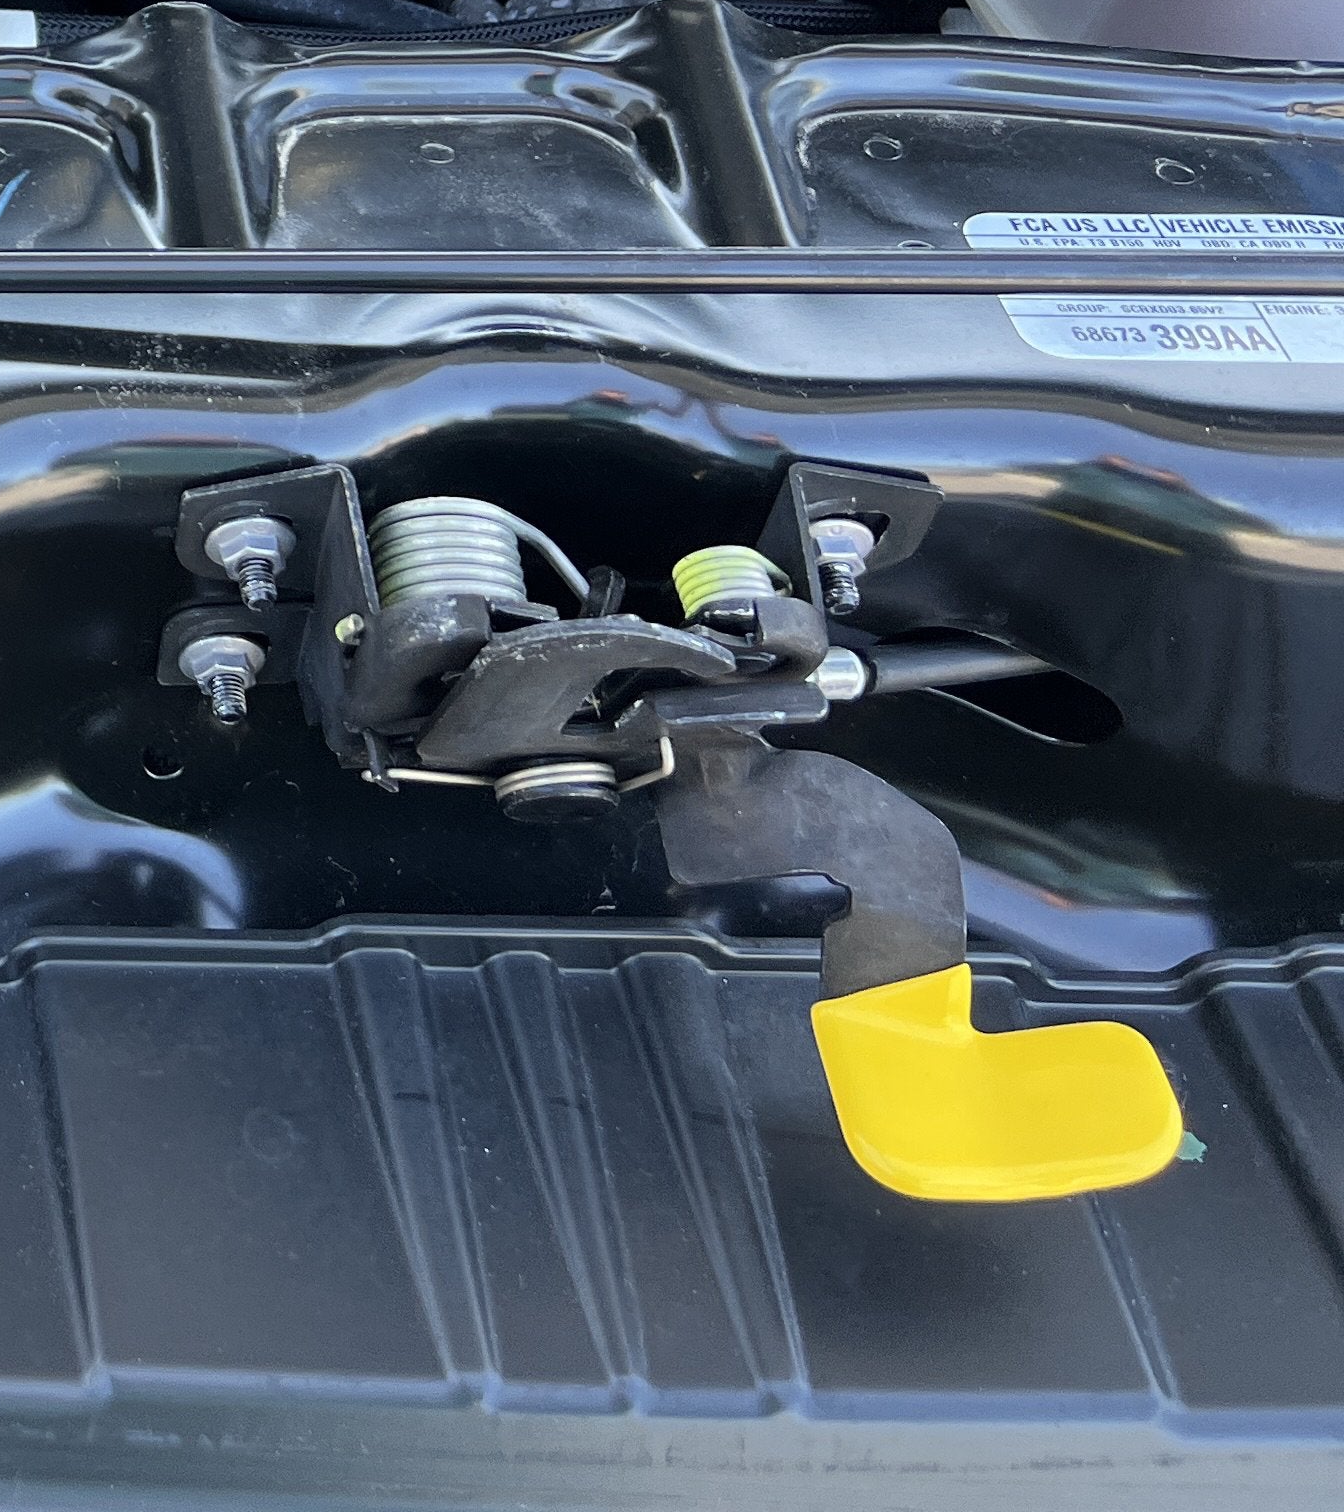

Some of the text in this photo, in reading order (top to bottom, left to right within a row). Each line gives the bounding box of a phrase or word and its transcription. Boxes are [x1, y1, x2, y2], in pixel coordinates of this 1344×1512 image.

[1007, 218, 1344, 235] FCA US LLC VEHICLE EMISSI
[1057, 304, 1110, 313] GROUP:
[1262, 304, 1332, 315] ENGINE:
[1071, 324, 1276, 352] 68673 399AA
